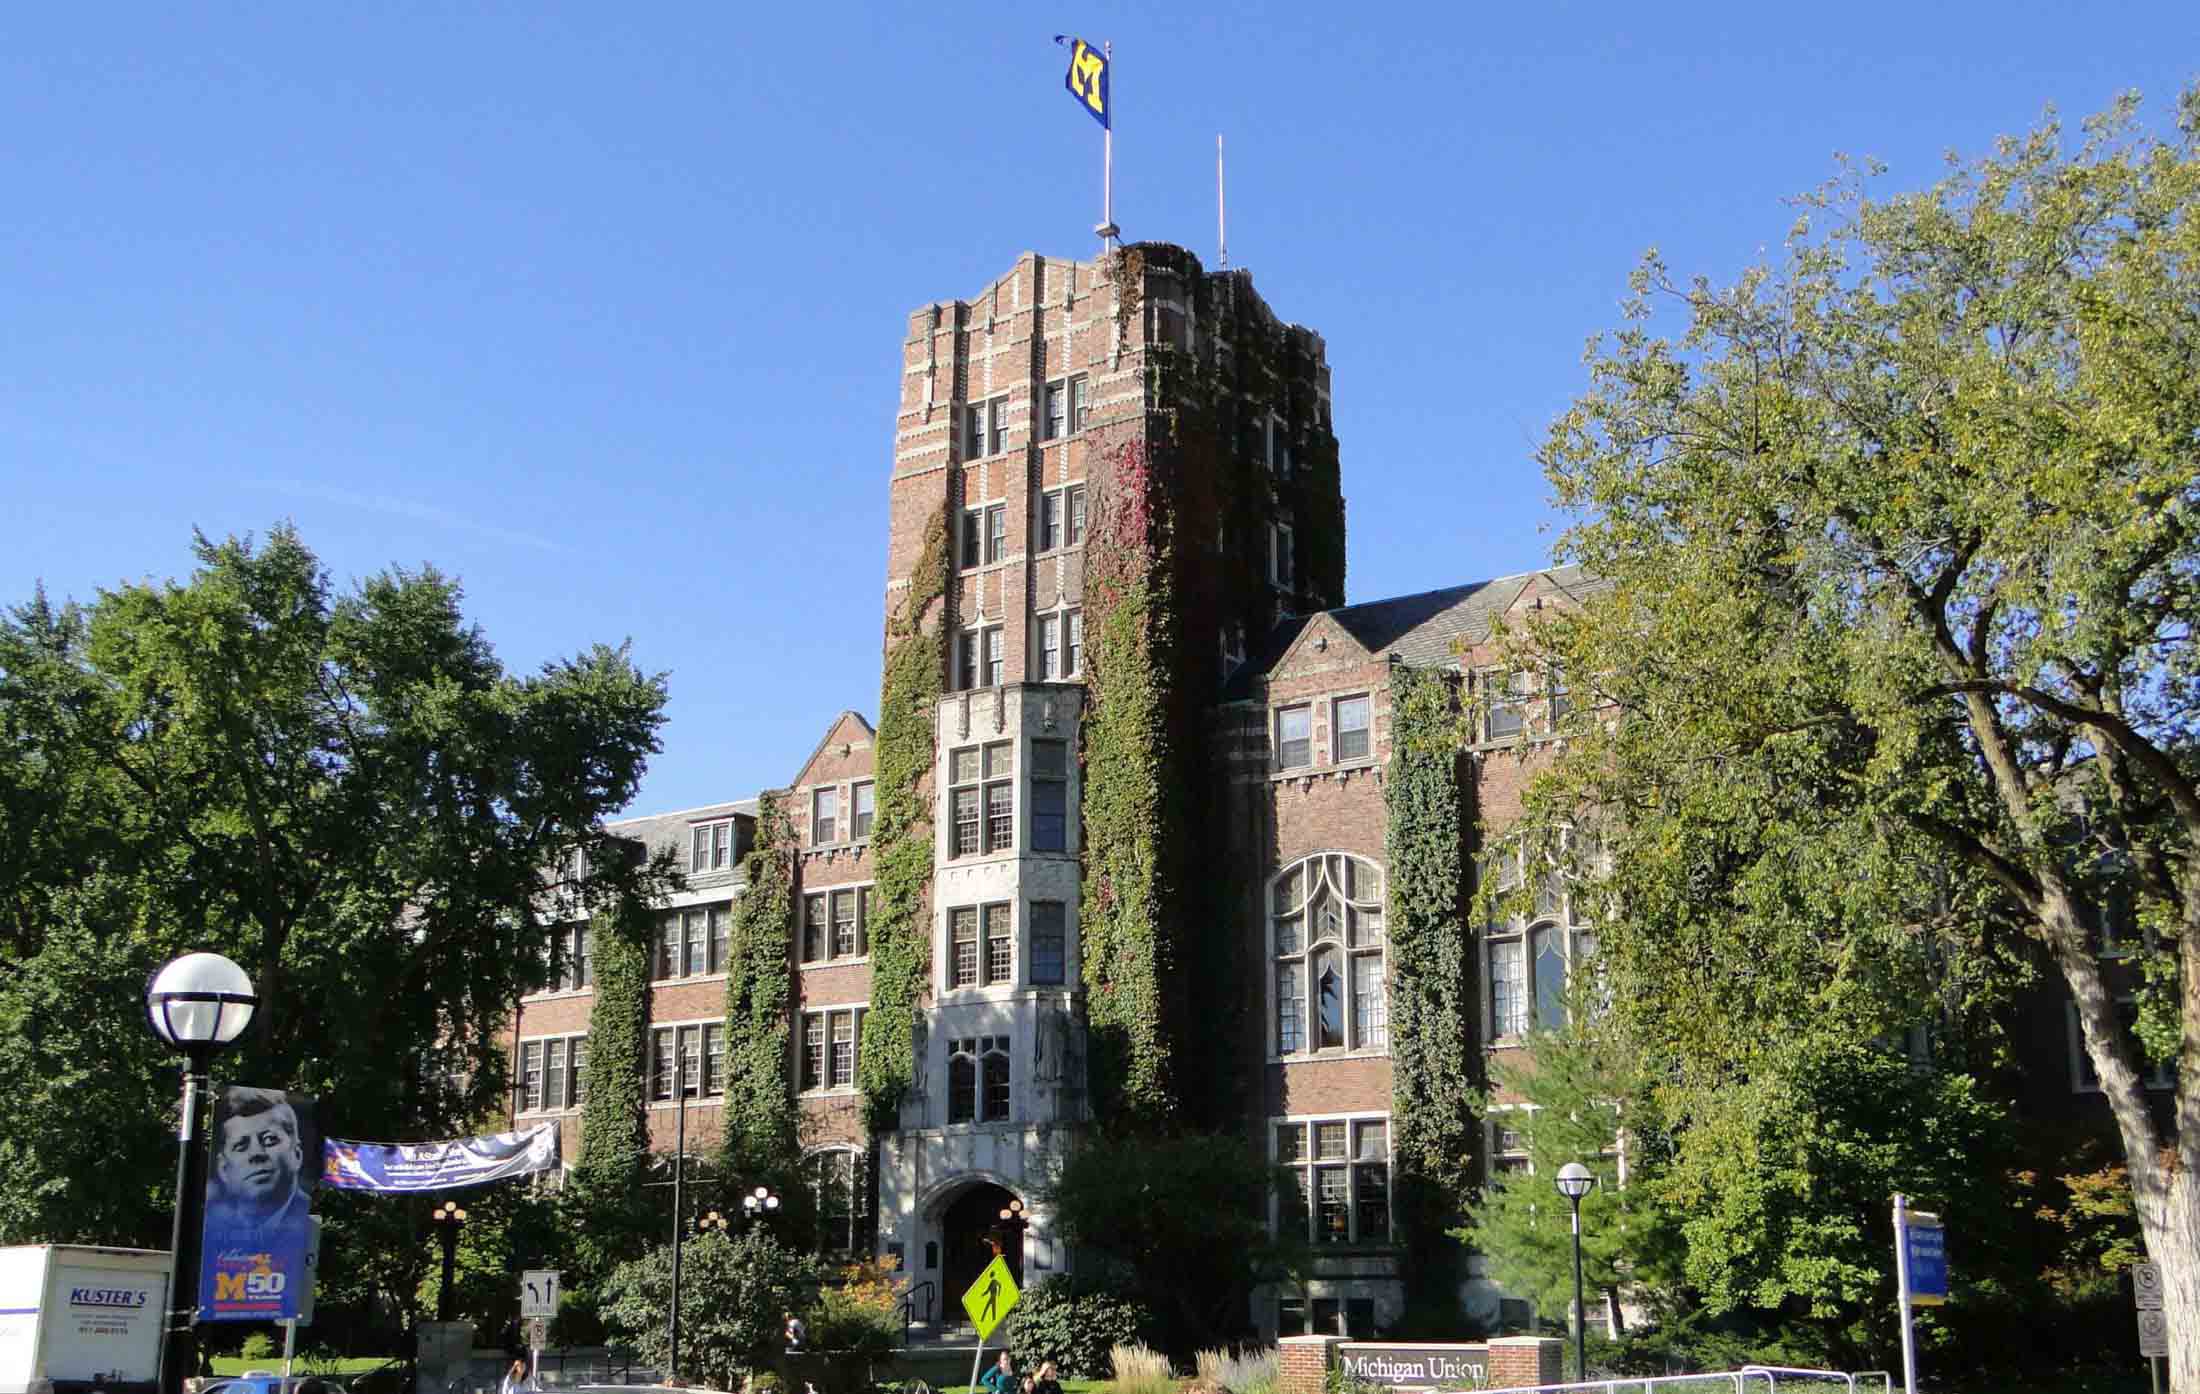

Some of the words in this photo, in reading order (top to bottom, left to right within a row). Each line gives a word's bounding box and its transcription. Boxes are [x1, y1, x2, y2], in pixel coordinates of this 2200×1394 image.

[1071, 40, 1104, 114] M
[71, 1288, 148, 1305] KUSTER'S
[1341, 1357, 1425, 1382] Michigan
[1427, 1357, 1484, 1378] Union
